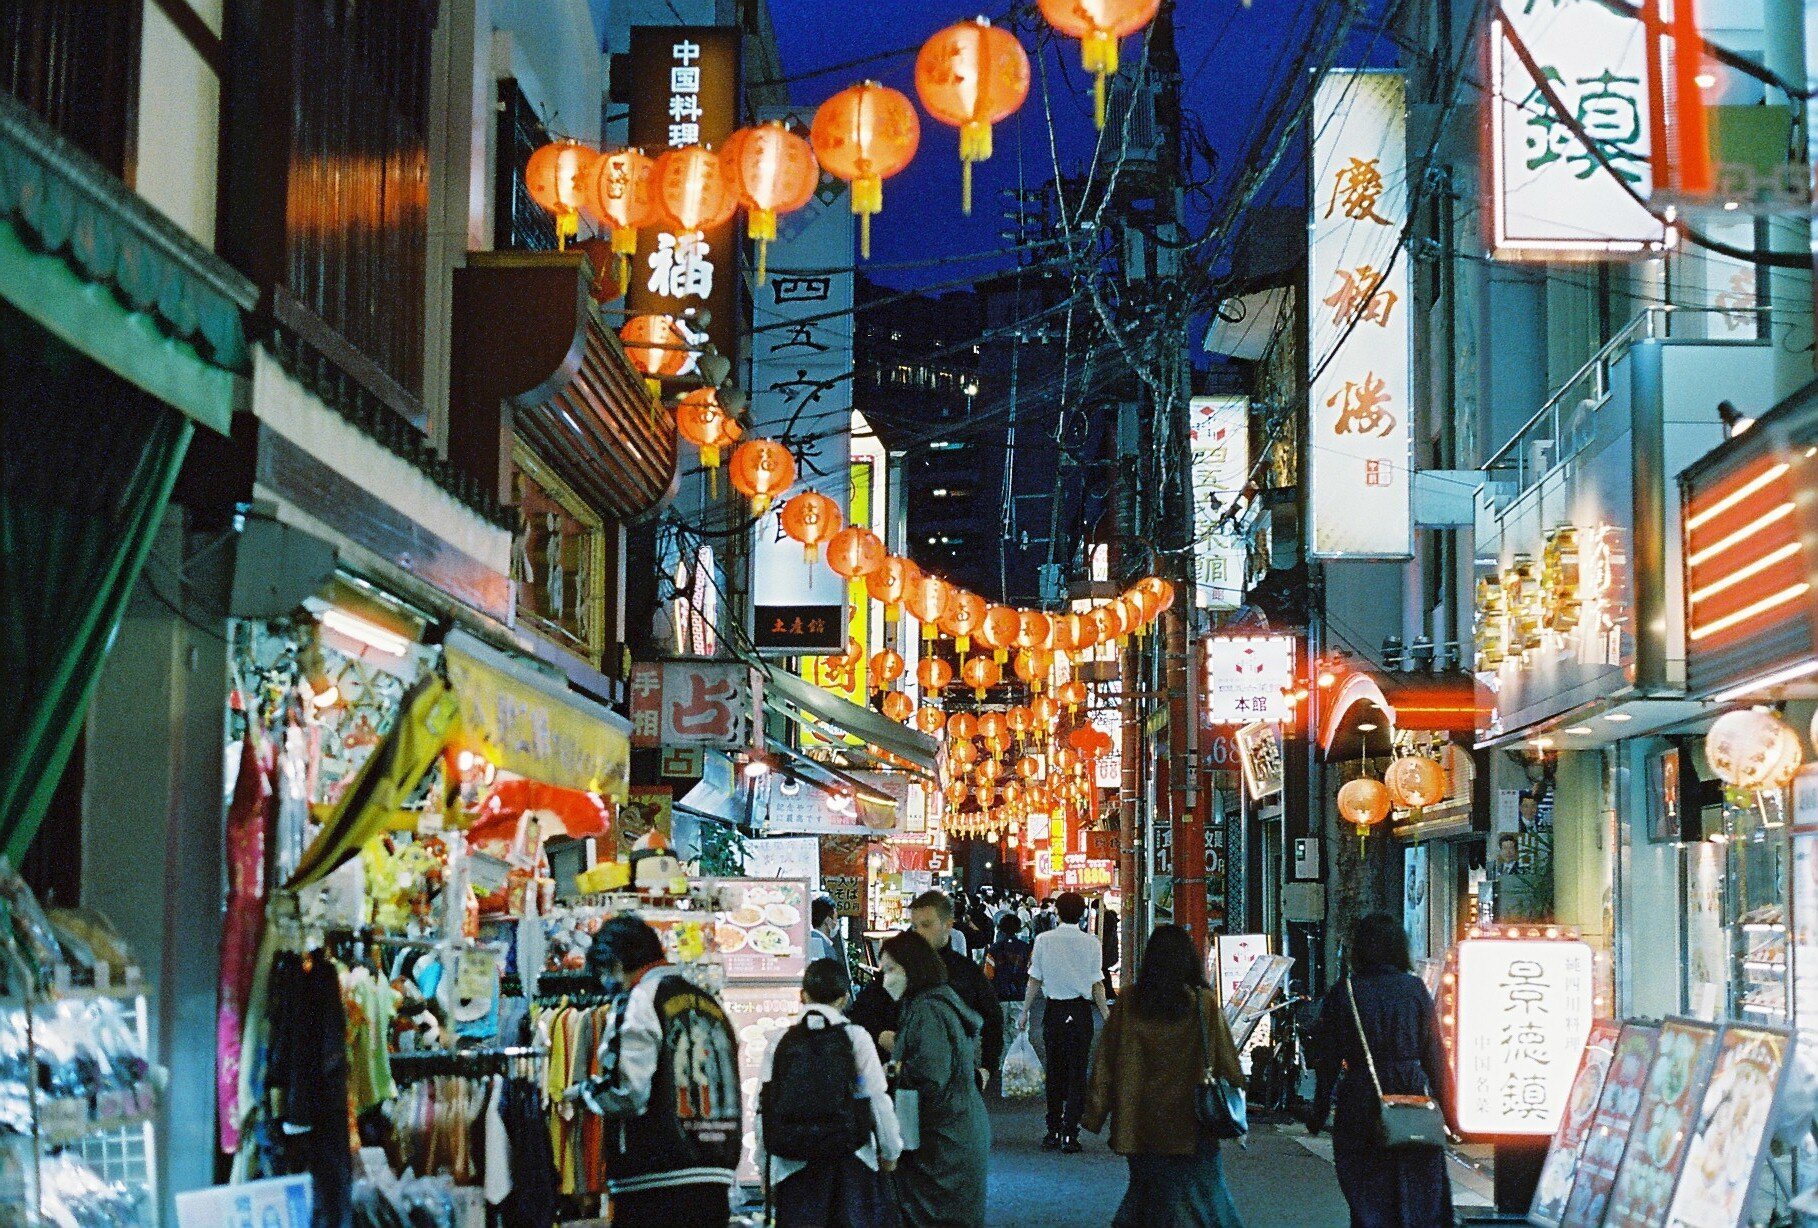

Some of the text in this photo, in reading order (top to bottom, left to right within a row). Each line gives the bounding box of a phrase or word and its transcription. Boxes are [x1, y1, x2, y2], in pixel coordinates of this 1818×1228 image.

[669, 39, 702, 149] 中国料理
[1523, 0, 1642, 183] 鎮
[770, 277, 830, 542] 四五六菜
[632, 670, 659, 737] 手相
[673, 673, 731, 736] 占
[1235, 696, 1267, 712] 本館
[663, 748, 693, 774] 占
[929, 852, 944, 869] 占
[829, 888, 859, 900] そば
